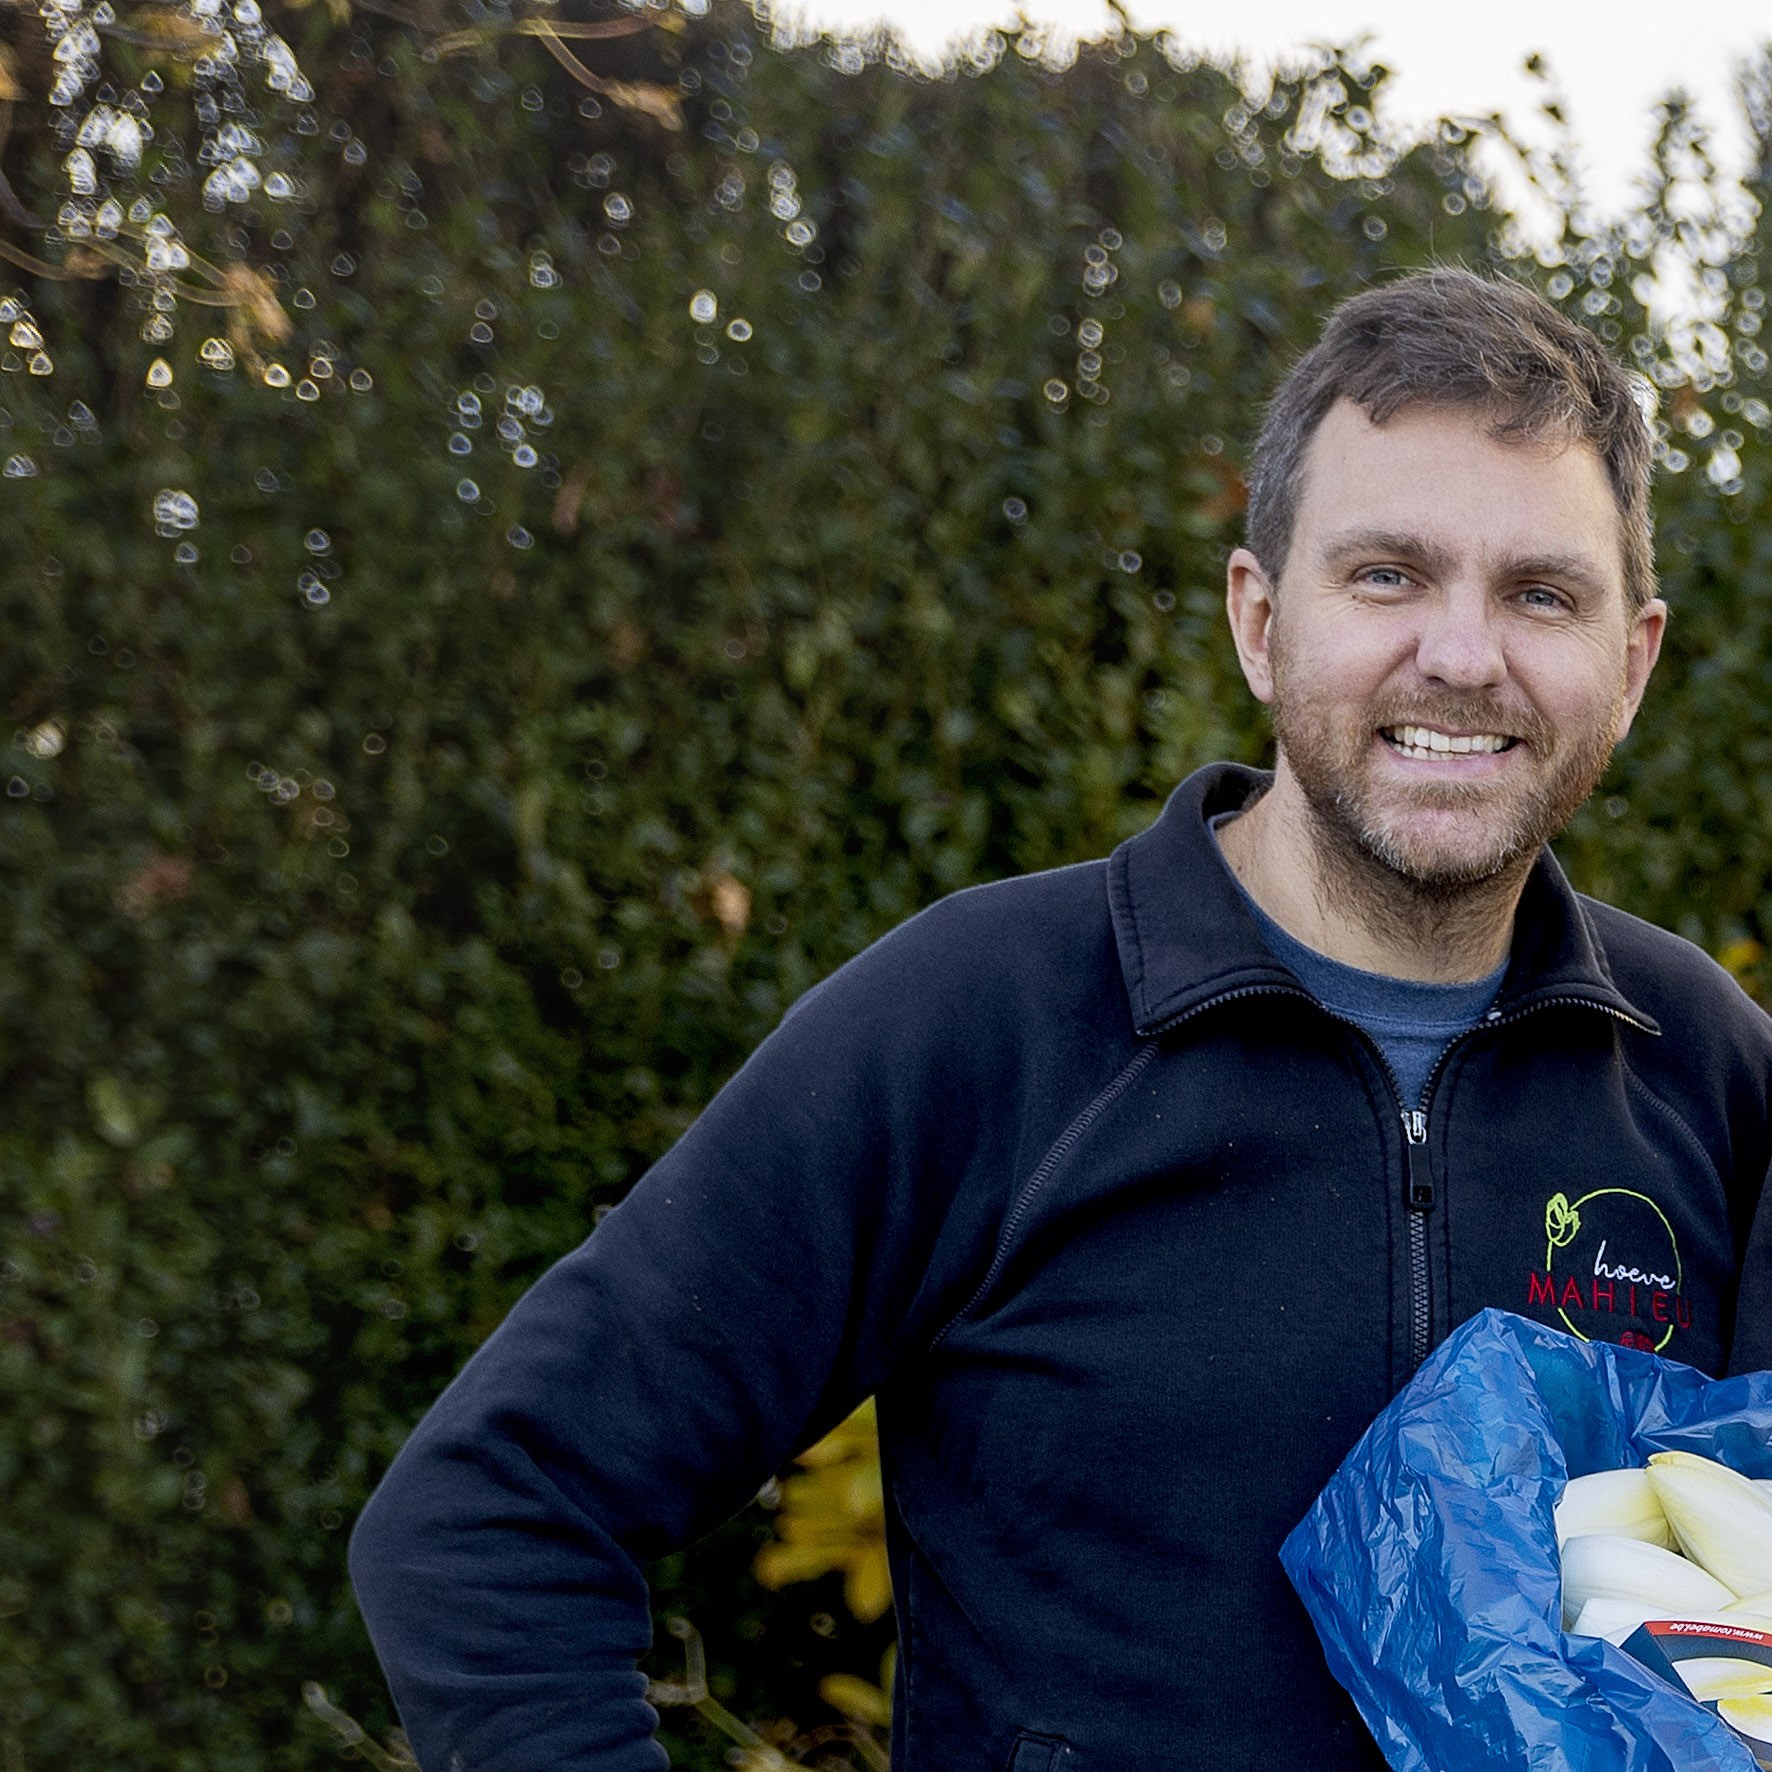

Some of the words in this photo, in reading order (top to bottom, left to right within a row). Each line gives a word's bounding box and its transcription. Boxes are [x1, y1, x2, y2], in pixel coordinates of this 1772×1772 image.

[1594, 1240, 1676, 1290] hoeve
[1528, 1271, 1692, 1329] MAHIEU
[1669, 1622, 1764, 1641] www.tomabel.be
